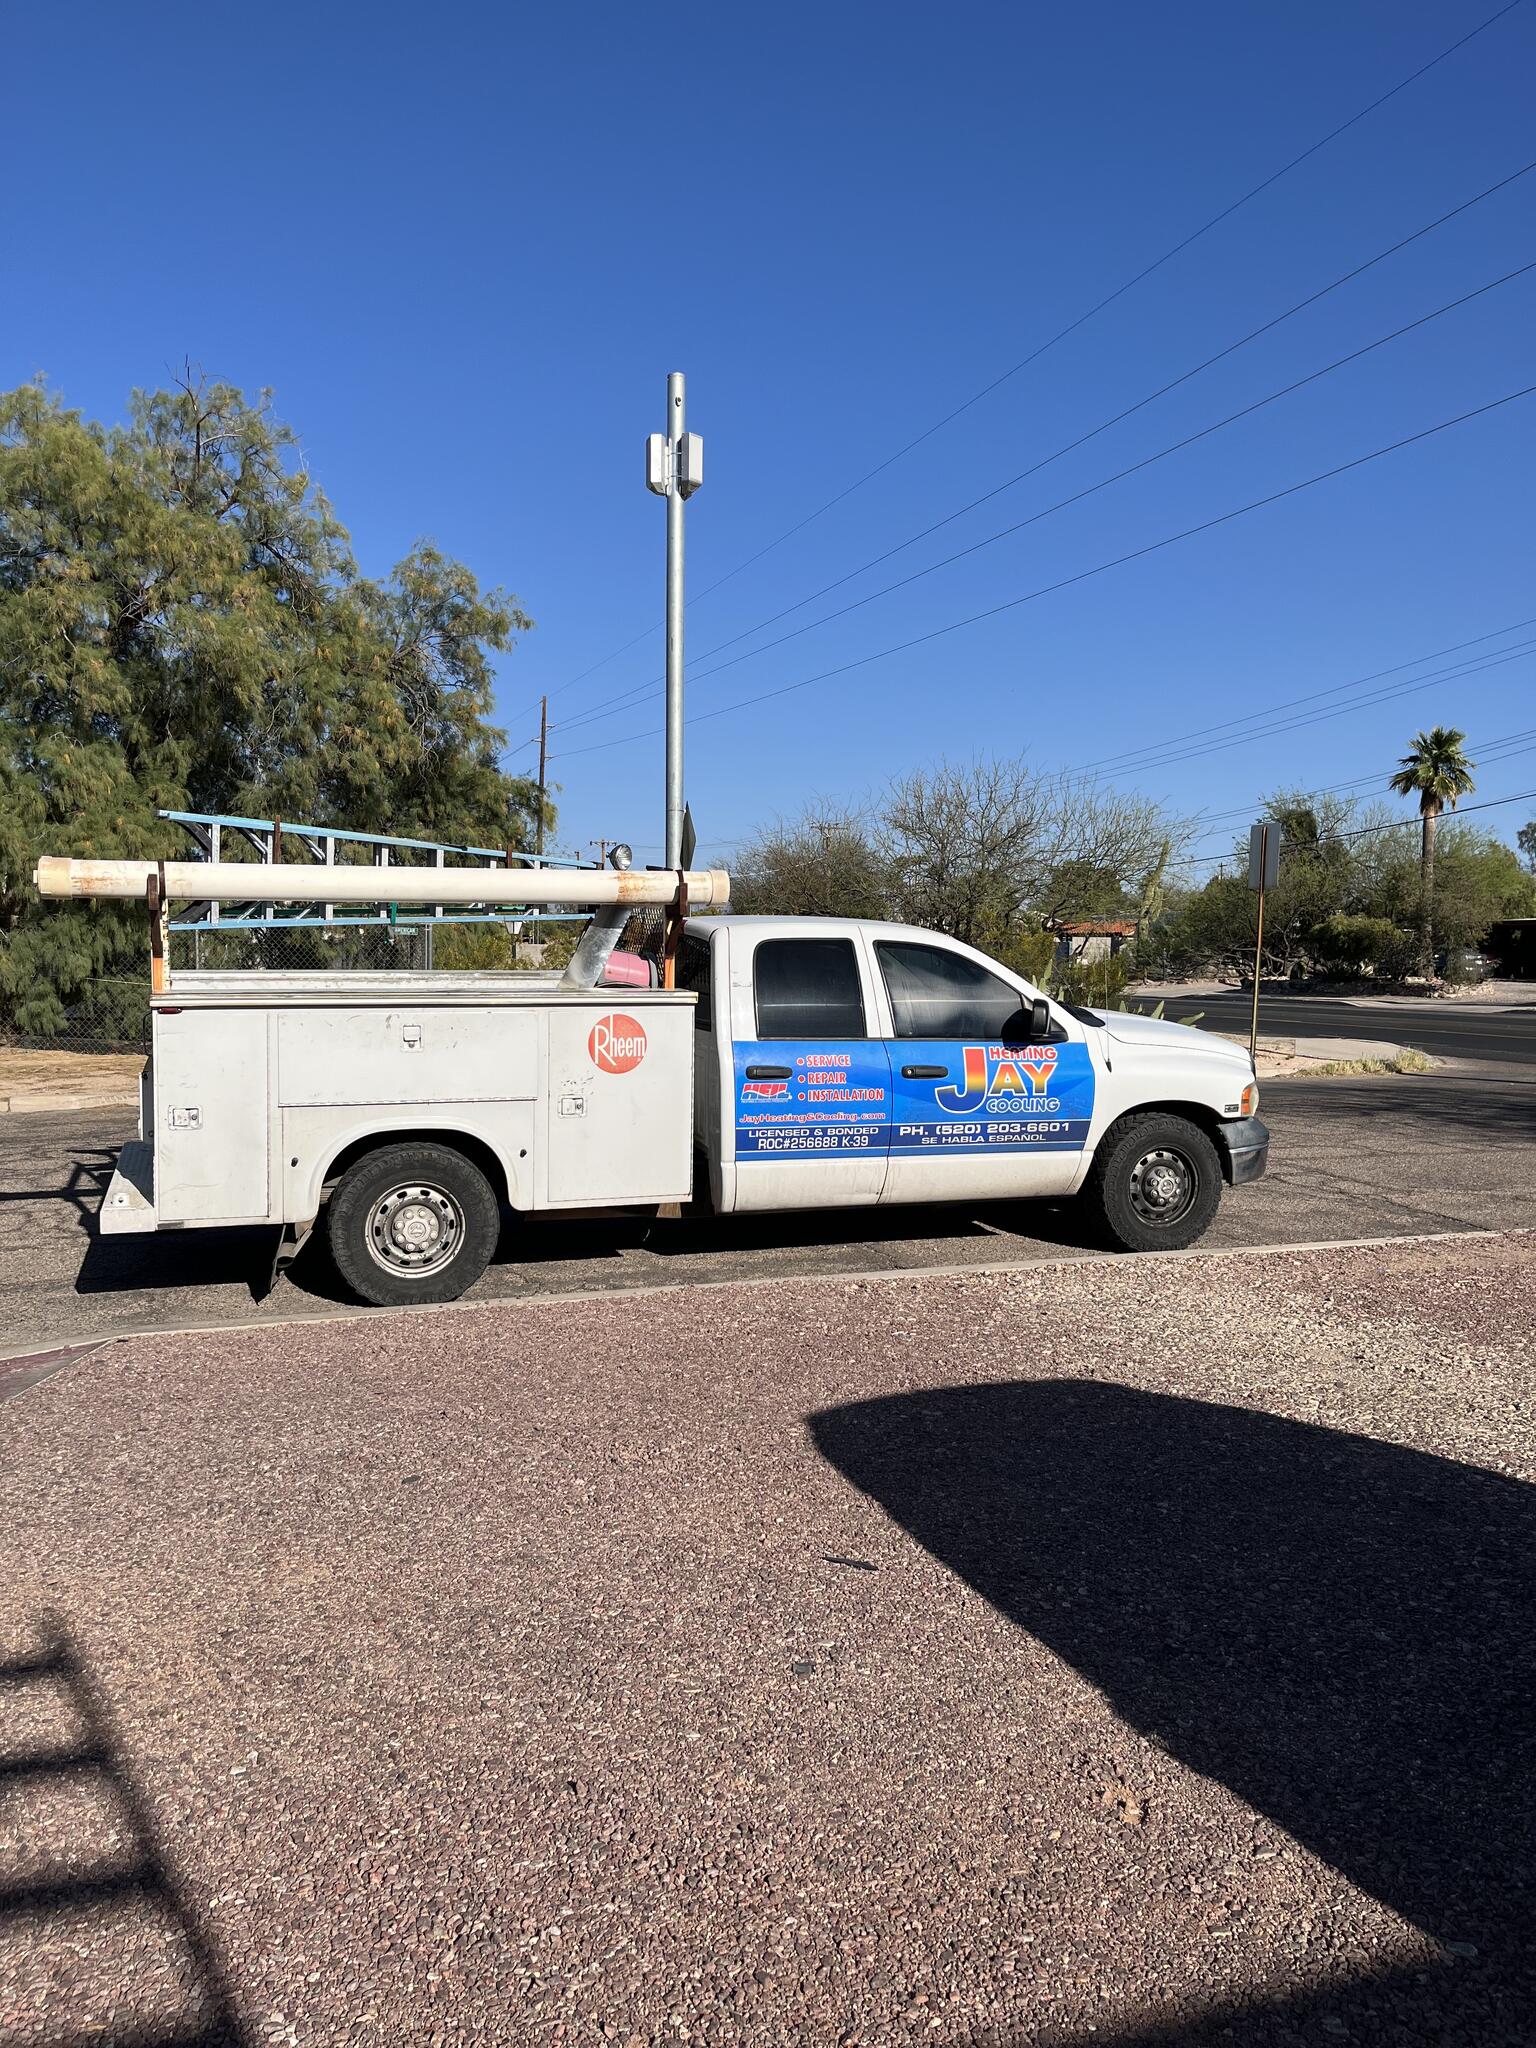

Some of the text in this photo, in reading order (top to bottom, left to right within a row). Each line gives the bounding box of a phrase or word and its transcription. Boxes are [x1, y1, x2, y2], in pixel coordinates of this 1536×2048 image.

[594, 1014, 645, 1066] Rheem
[990, 1046, 1057, 1060] HEATING
[807, 1055, 851, 1067] SERVICE
[807, 1072, 847, 1084] REPAIR
[934, 1046, 1058, 1113] JAY
[741, 1083, 788, 1100] HEIL
[808, 1088, 884, 1102] INSTALLATION
[986, 1097, 1060, 1113] COOLING
[739, 1112, 886, 1125] JayHeating&Cooling.com
[748, 1127, 879, 1138] LICENSED & BONDED
[900, 1122, 1070, 1136] PH. (520) 203-6601
[758, 1136, 869, 1150] ROC#256688 K-39
[921, 1133, 1046, 1145] SE HABLA ESPAÑOL
